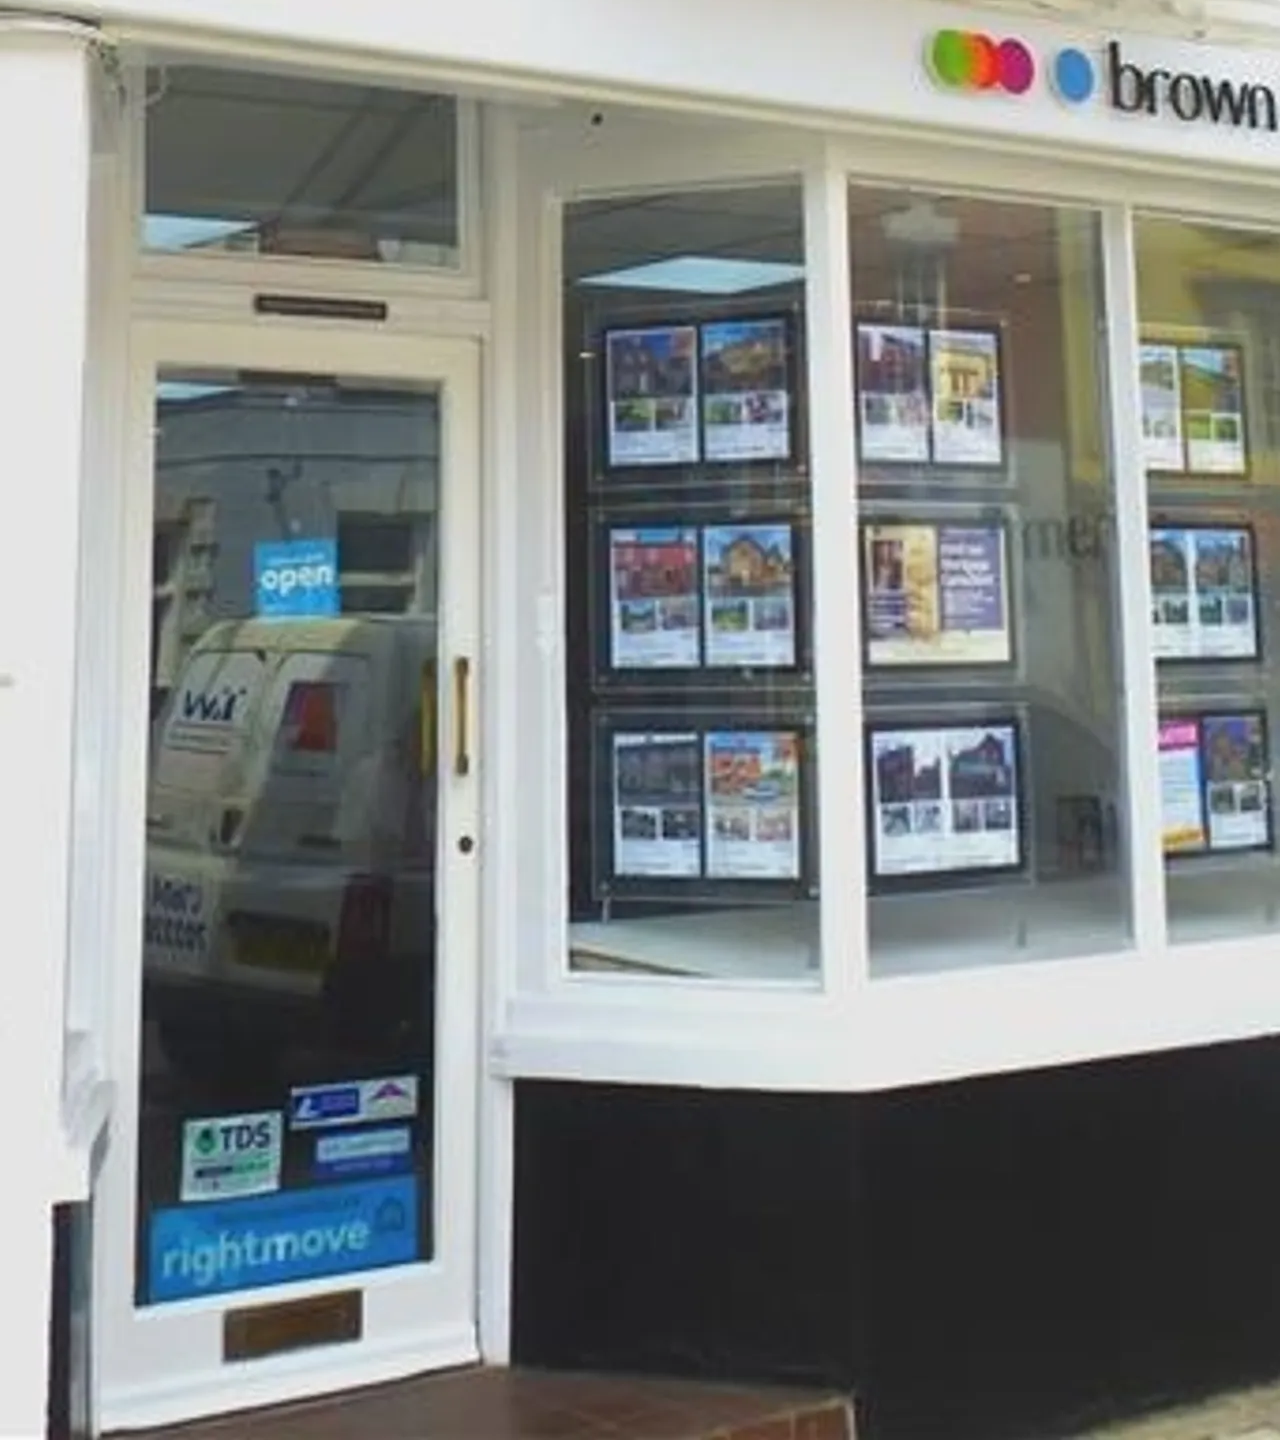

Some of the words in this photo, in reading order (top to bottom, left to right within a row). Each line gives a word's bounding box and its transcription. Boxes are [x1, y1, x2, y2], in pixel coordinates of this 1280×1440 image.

[261, 564, 334, 598] open
[219, 1121, 271, 1152] TDS
[161, 1220, 370, 1287] rightmove
